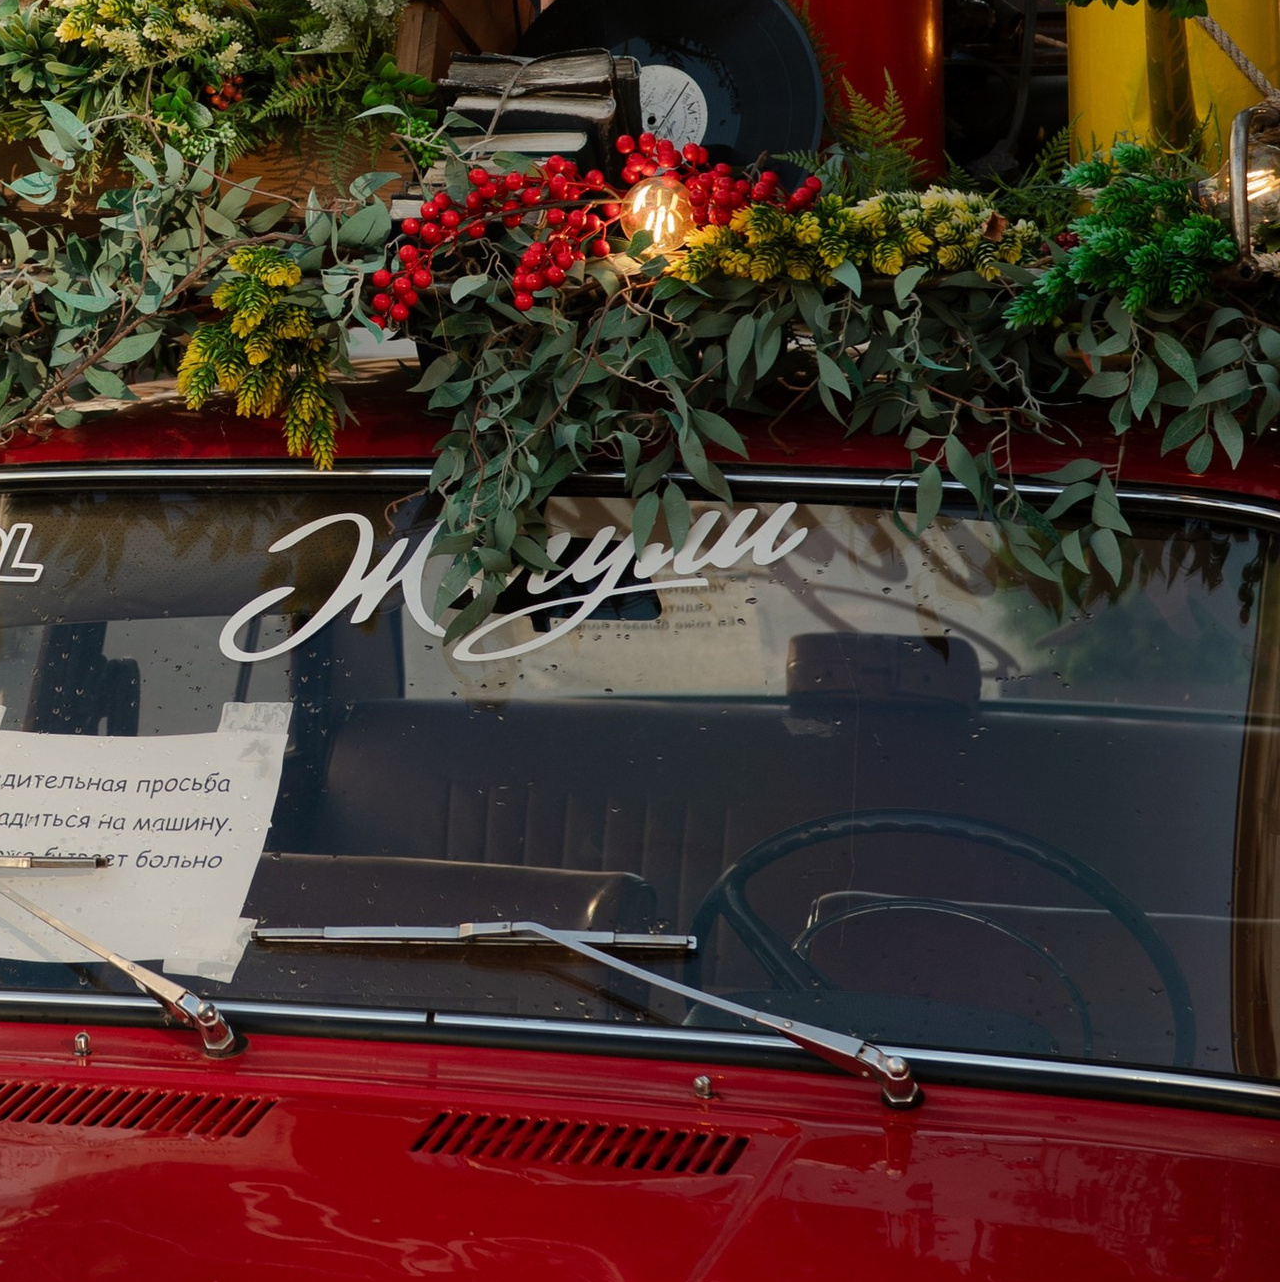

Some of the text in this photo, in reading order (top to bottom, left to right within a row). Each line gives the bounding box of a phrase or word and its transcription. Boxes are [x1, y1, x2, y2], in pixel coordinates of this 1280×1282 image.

[135, 772, 231, 799] просьба
[97, 813, 126, 831] на
[132, 817, 233, 837] машину.
[134, 849, 223, 869] больно
